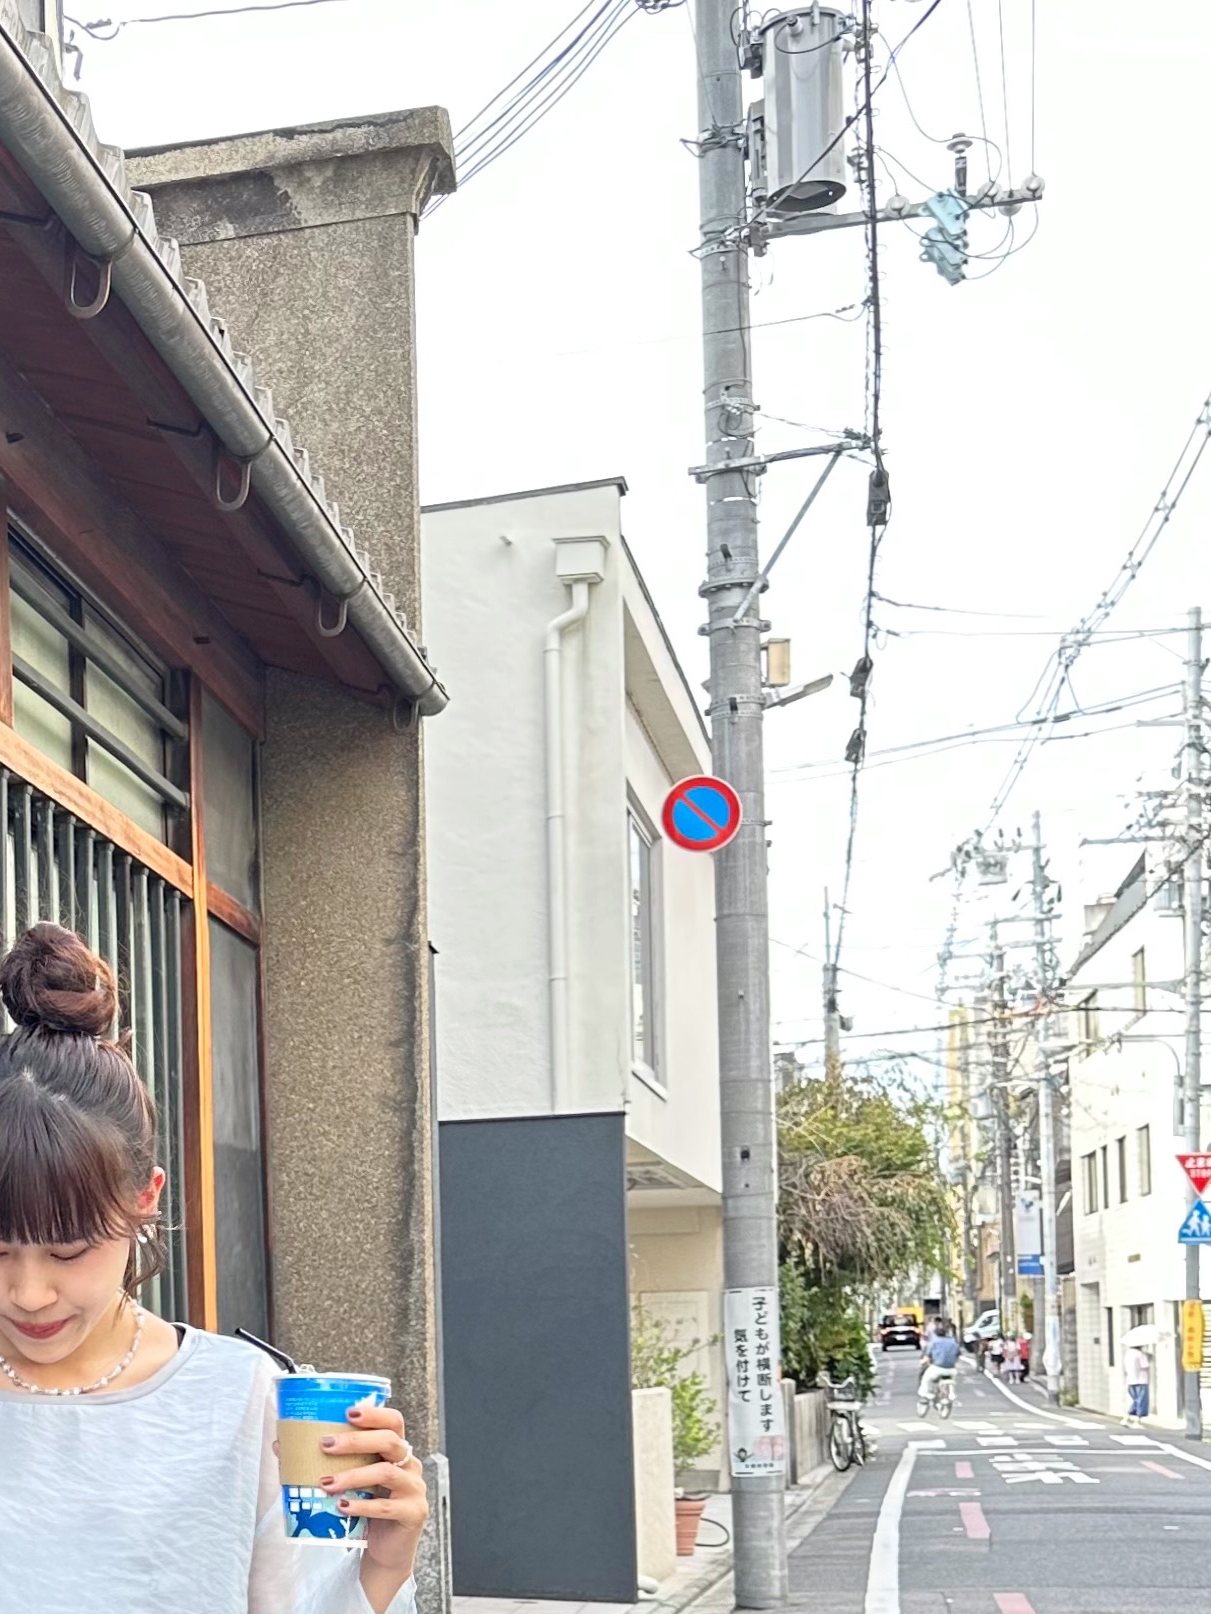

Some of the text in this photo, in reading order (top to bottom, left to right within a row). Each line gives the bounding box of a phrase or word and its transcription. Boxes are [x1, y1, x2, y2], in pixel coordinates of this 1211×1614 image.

[734, 1328, 751, 1403] 気を付けて
[752, 1296, 774, 1432] 子どもが横断します
